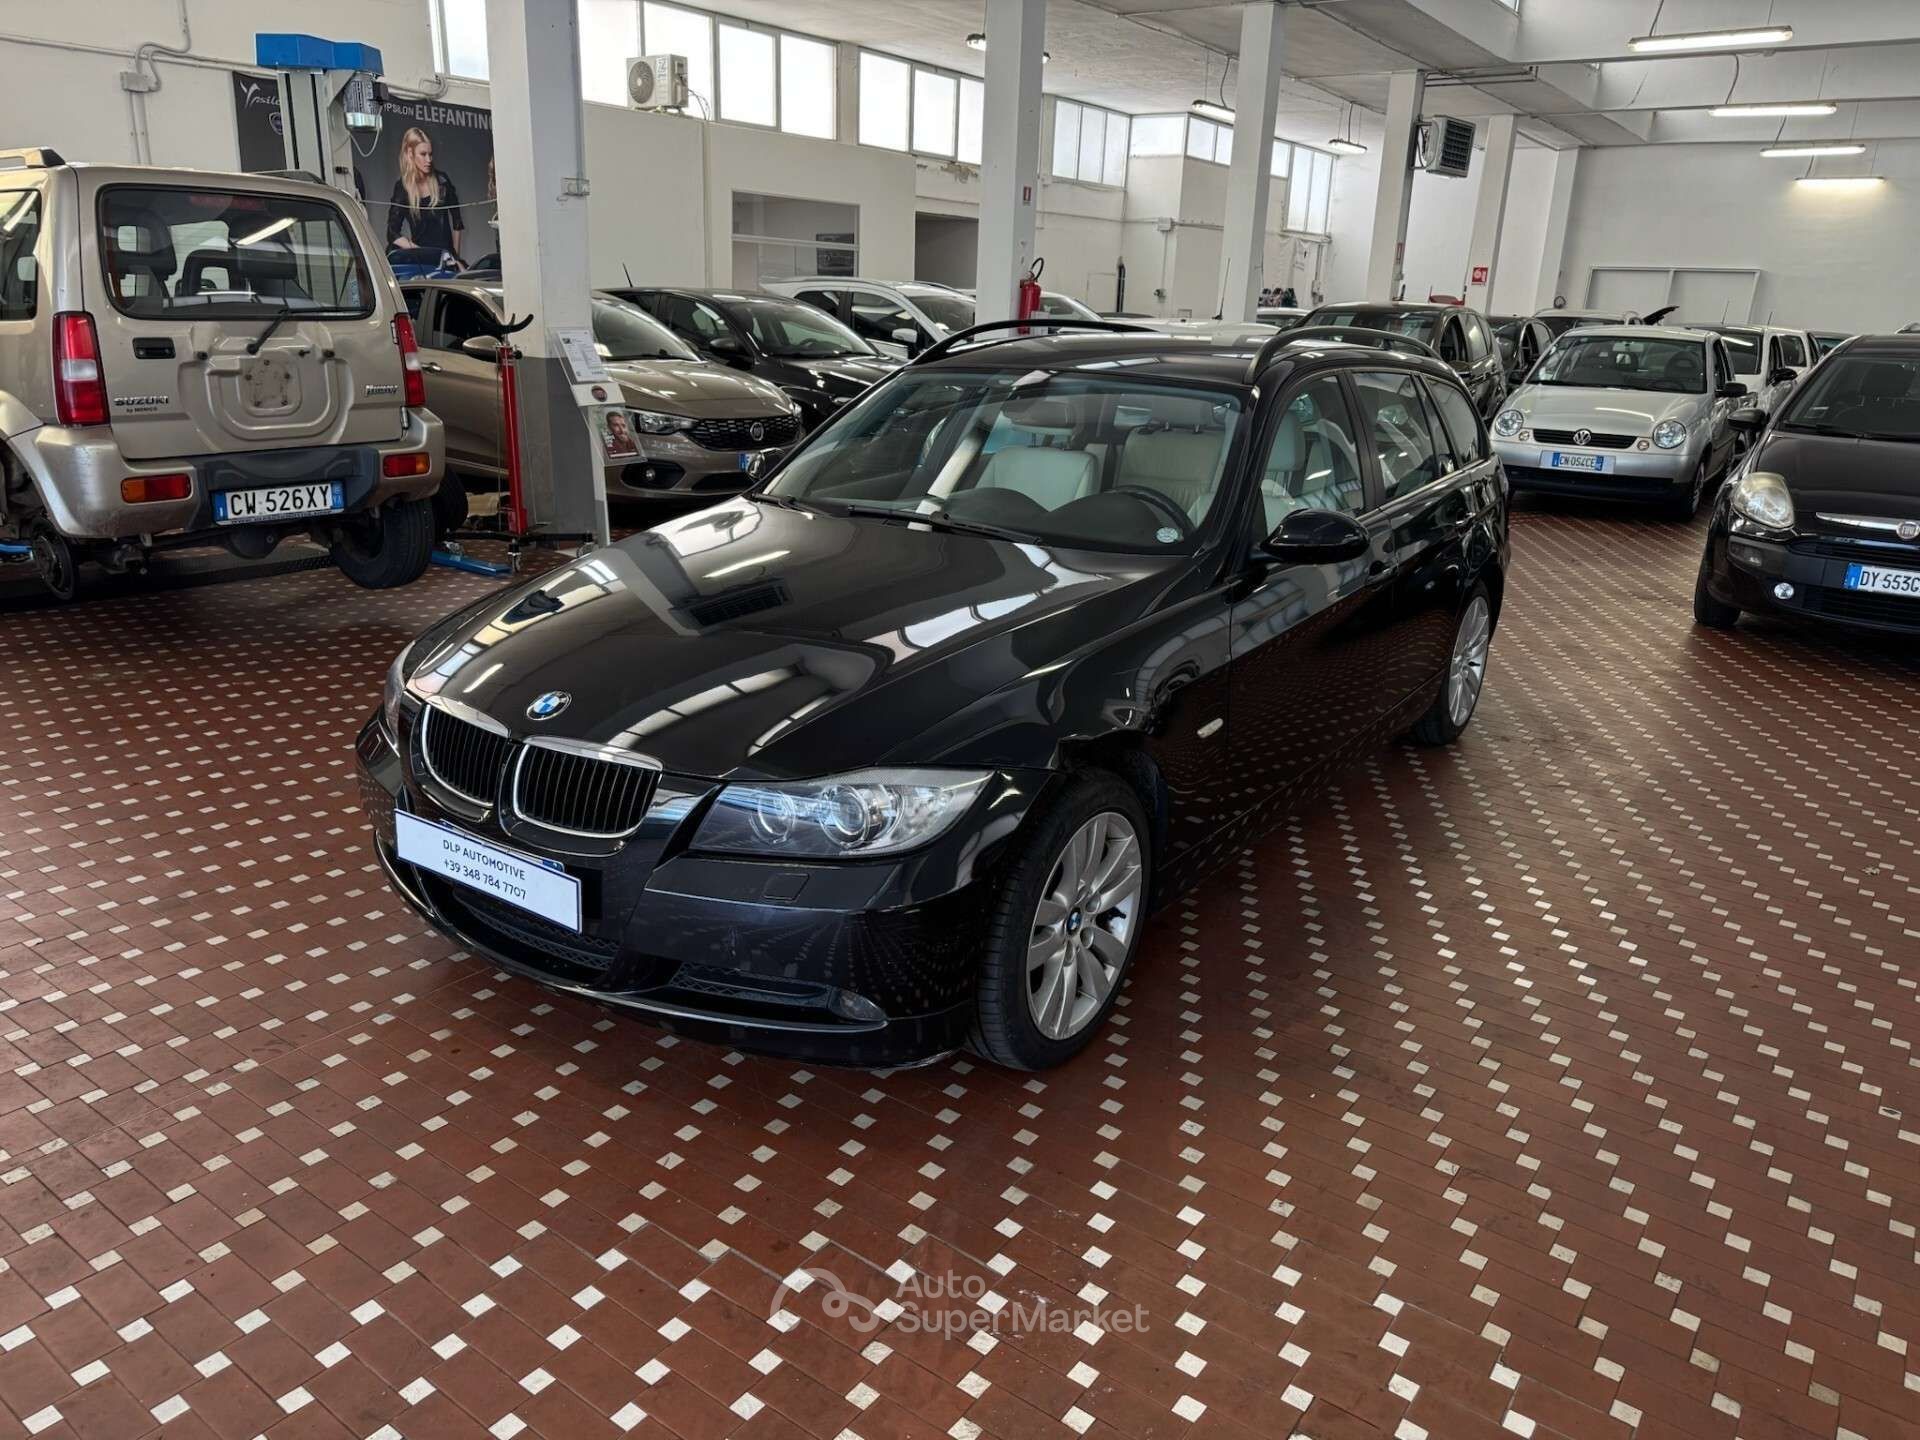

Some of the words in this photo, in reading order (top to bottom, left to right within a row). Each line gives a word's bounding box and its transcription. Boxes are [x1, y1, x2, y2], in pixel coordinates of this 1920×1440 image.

[113, 396, 169, 406] SUZUKI
[230, 493, 256, 516] CW
[266, 485, 329, 513] 526XY
[1860, 571, 1880, 587] DY
[443, 840, 461, 853] DLP
[463, 848, 526, 881] AUTOMOTIVE
[444, 859, 461, 873] +39
[463, 865, 481, 881] 348
[483, 873, 501, 890] 784
[503, 881, 527, 901] 7707
